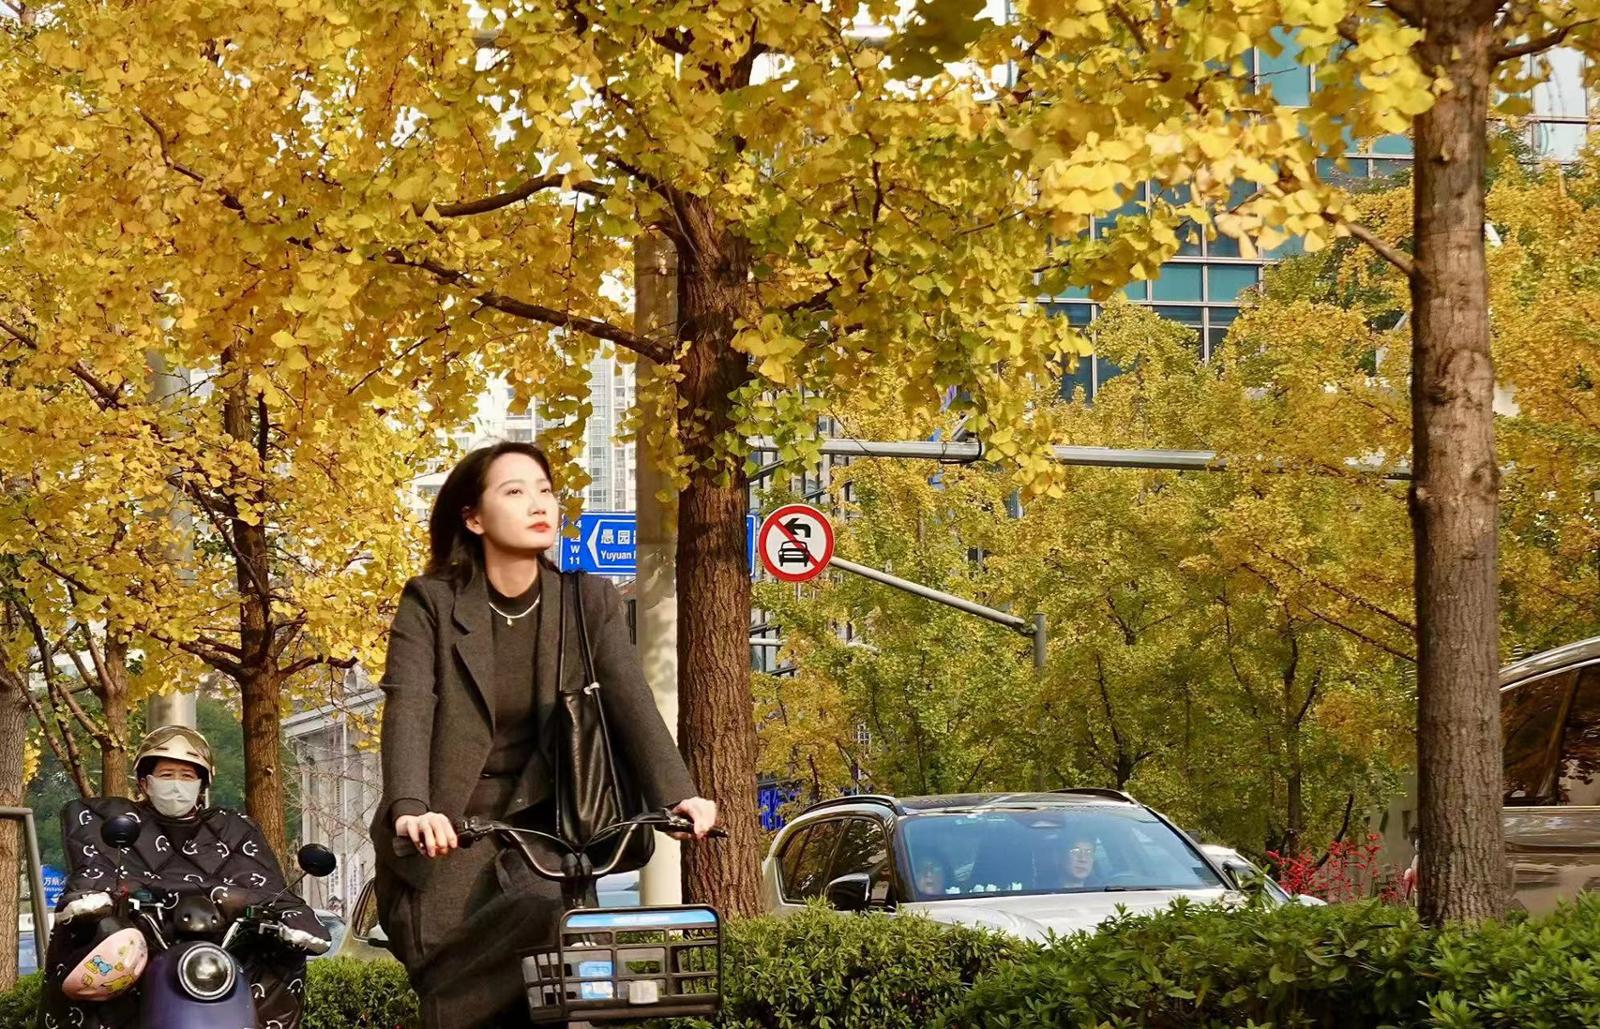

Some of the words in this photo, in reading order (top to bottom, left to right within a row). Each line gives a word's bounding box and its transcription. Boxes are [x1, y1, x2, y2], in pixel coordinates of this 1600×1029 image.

[600, 529, 636, 544] 愚园
[570, 545, 580, 554] W
[569, 556, 580, 565] 11
[601, 550, 632, 562] Yuyuan
